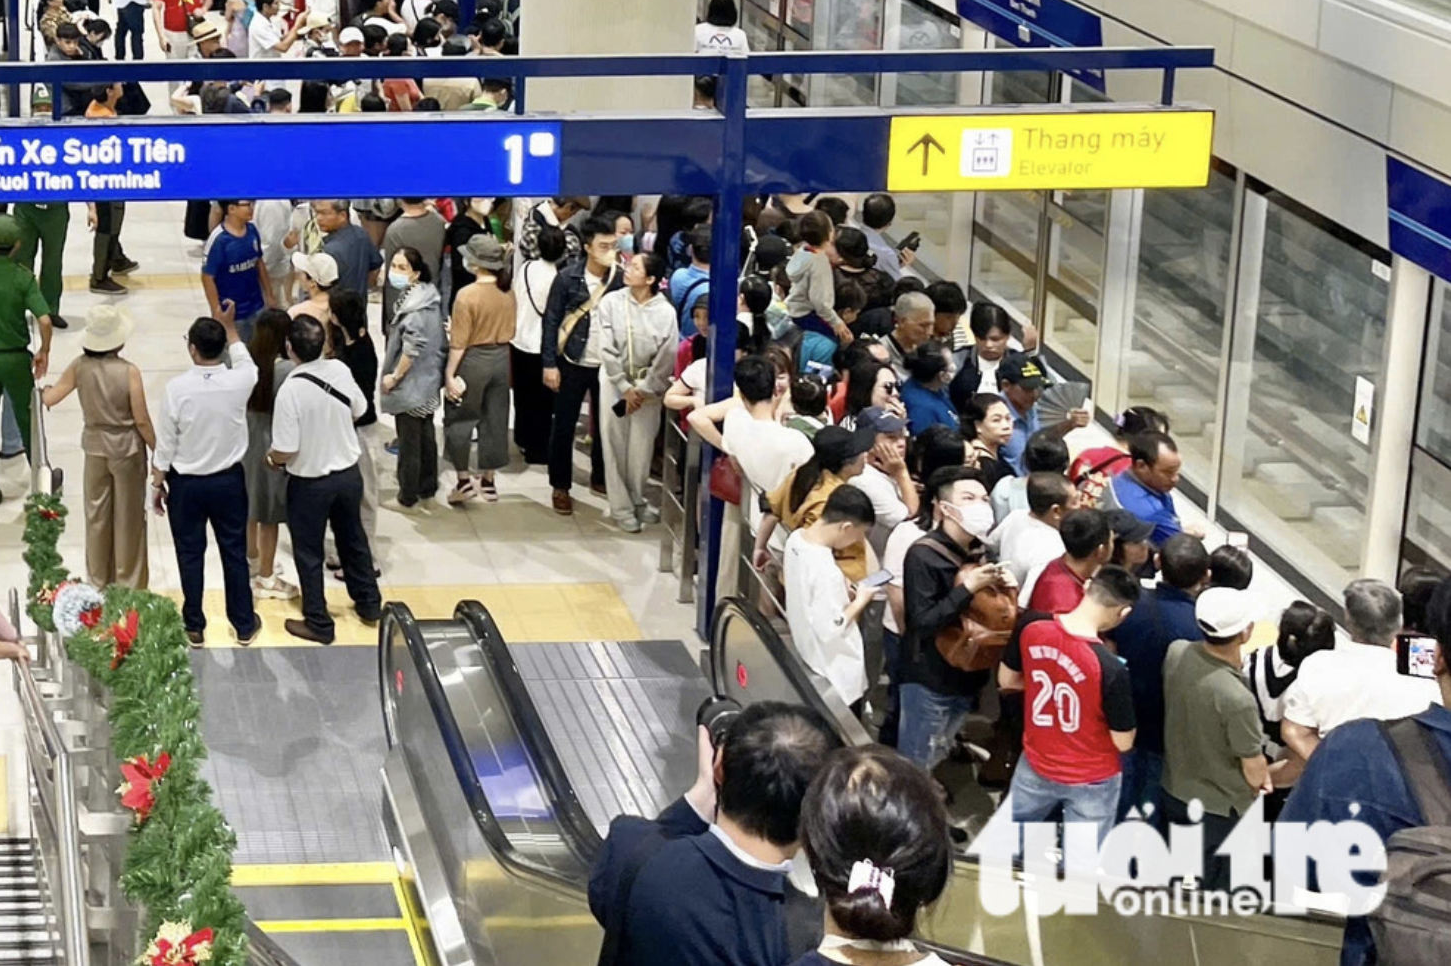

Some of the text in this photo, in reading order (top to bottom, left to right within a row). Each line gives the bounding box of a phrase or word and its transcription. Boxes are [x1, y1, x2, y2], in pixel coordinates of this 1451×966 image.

[20, 138, 58, 166] Xe
[62, 134, 123, 166] Suối
[127, 136, 186, 165] Tiên
[1022, 125, 1167, 153] Thang máy
[503, 134, 524, 185] 1
[1018, 159, 1093, 177] Elevator
[31, 170, 74, 191] Tien
[75, 168, 162, 190] Terminal
[1031, 670, 1081, 733] 20
